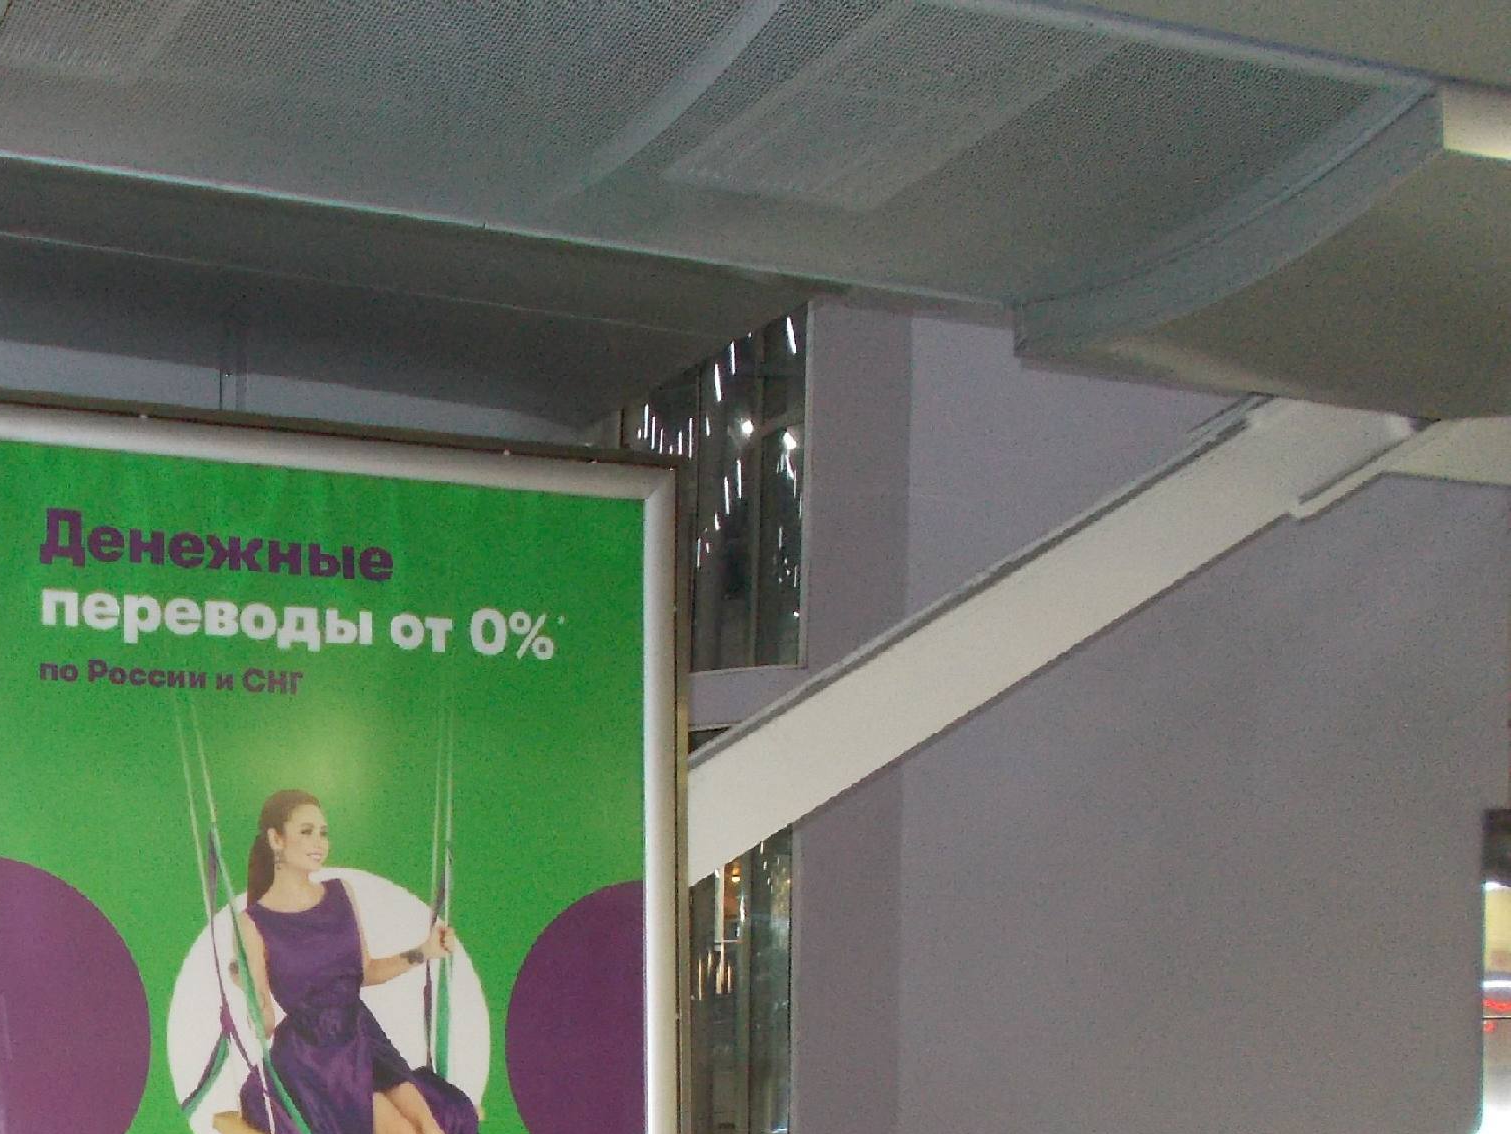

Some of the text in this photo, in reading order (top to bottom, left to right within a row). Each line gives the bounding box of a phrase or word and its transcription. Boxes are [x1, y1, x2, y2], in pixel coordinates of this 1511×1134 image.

[40, 508, 395, 582] Денежные
[41, 588, 374, 653] переводы
[391, 613, 454, 654] от
[40, 659, 304, 695] по России и СНГ
